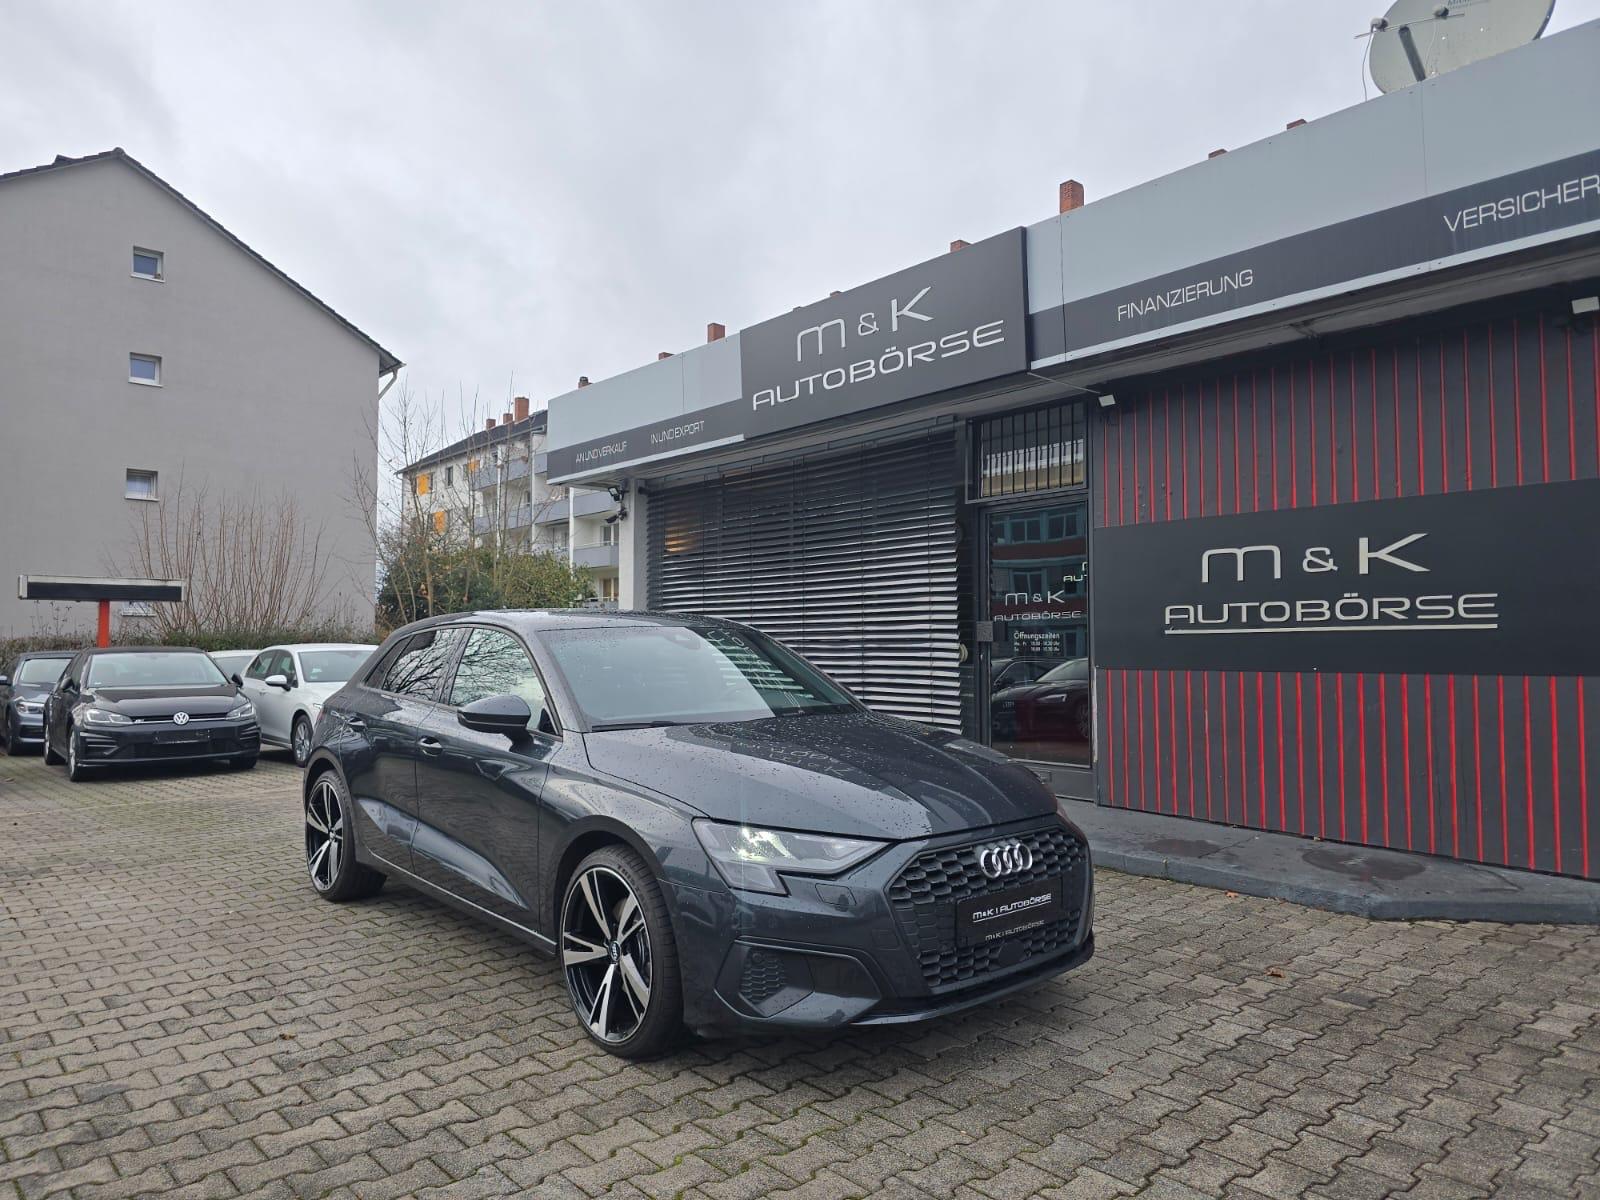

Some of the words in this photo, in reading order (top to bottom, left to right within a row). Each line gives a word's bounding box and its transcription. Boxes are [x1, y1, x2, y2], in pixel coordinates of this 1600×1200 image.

[1443, 174, 1600, 232] VERSICHER
[1117, 268, 1254, 322] FINANZIERUNG
[797, 317, 846, 362] M
[857, 312, 880, 337] &
[891, 286, 935, 332] K
[752, 319, 1005, 412] AUTOBÖRSE
[1201, 544, 1281, 583] M
[1302, 547, 1339, 573] &
[1358, 533, 1431, 575] K
[994, 610, 1082, 622] AUTOBÖRSE
[1005, 592, 1028, 607] M
[1032, 593, 1043, 603] &
[1047, 589, 1065, 604] K
[1164, 592, 1499, 625] AUTOBÖRSE
[1000, 894, 1051, 913] AUTOBÖRSE
